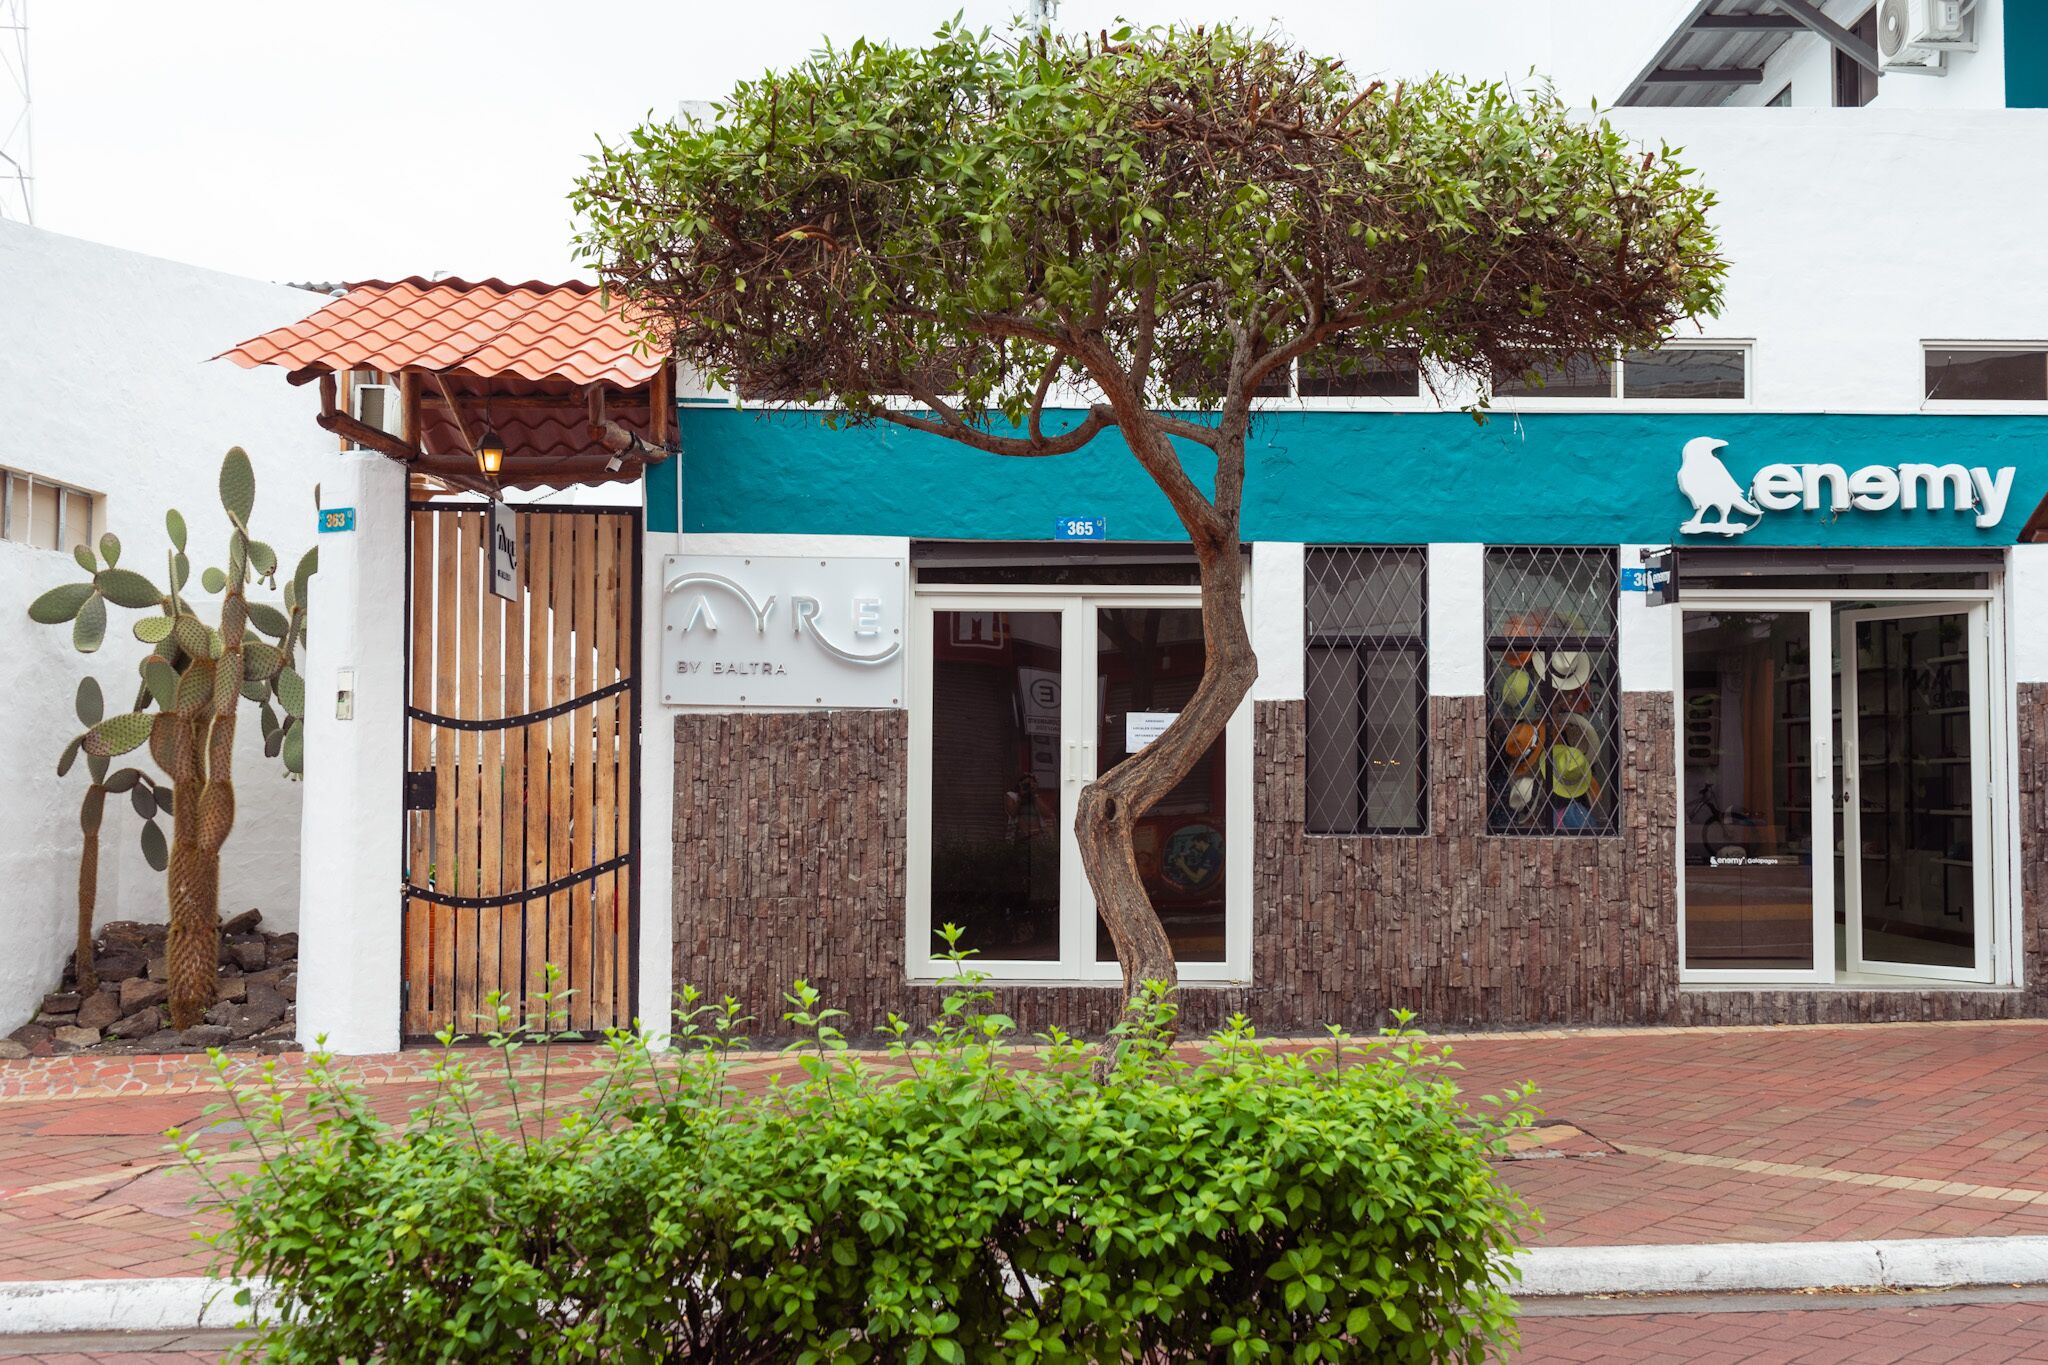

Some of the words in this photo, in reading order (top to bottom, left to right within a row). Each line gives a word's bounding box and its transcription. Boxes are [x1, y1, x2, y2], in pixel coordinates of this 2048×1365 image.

[1753, 463, 2016, 528] enemy
[326, 512, 345, 528] 363
[1067, 521, 1094, 536] 365
[665, 572, 900, 665] AYRE
[677, 661, 702, 674] BY
[713, 662, 788, 675] BALTRA
